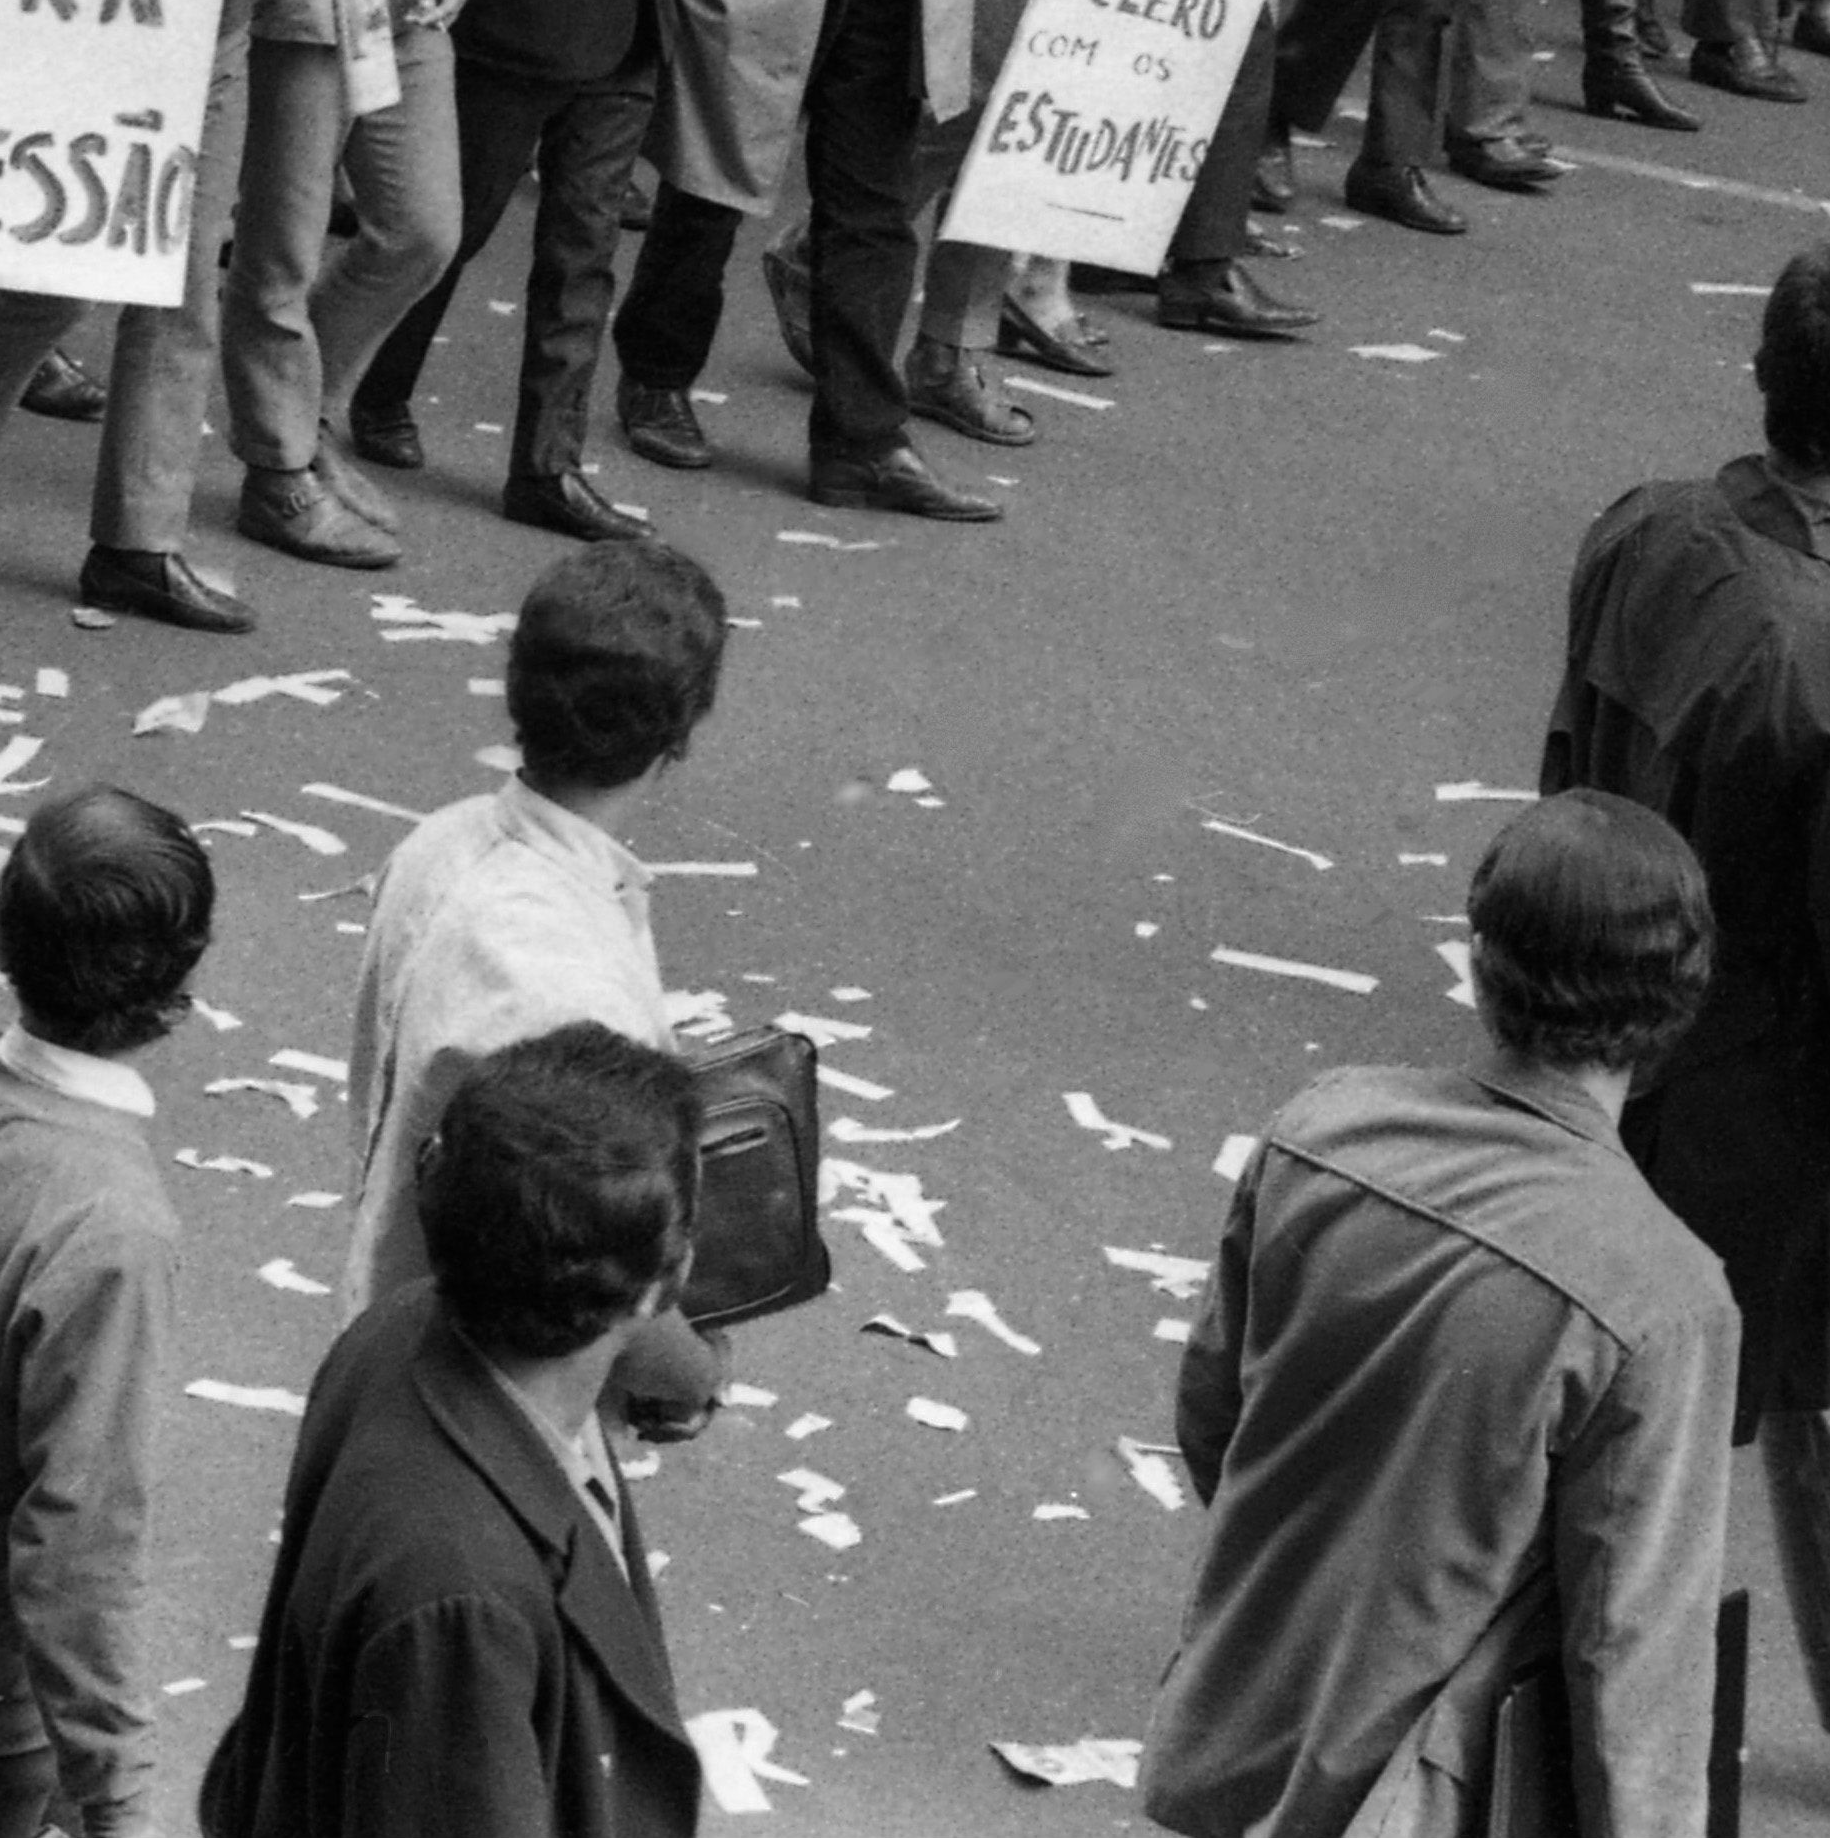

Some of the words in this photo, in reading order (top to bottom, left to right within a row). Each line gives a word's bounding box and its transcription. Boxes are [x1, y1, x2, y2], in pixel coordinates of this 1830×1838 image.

[1026, 28, 1101, 67] COM
[1131, 51, 1174, 83] OS
[987, 88, 1210, 185] ESTUDANTES
